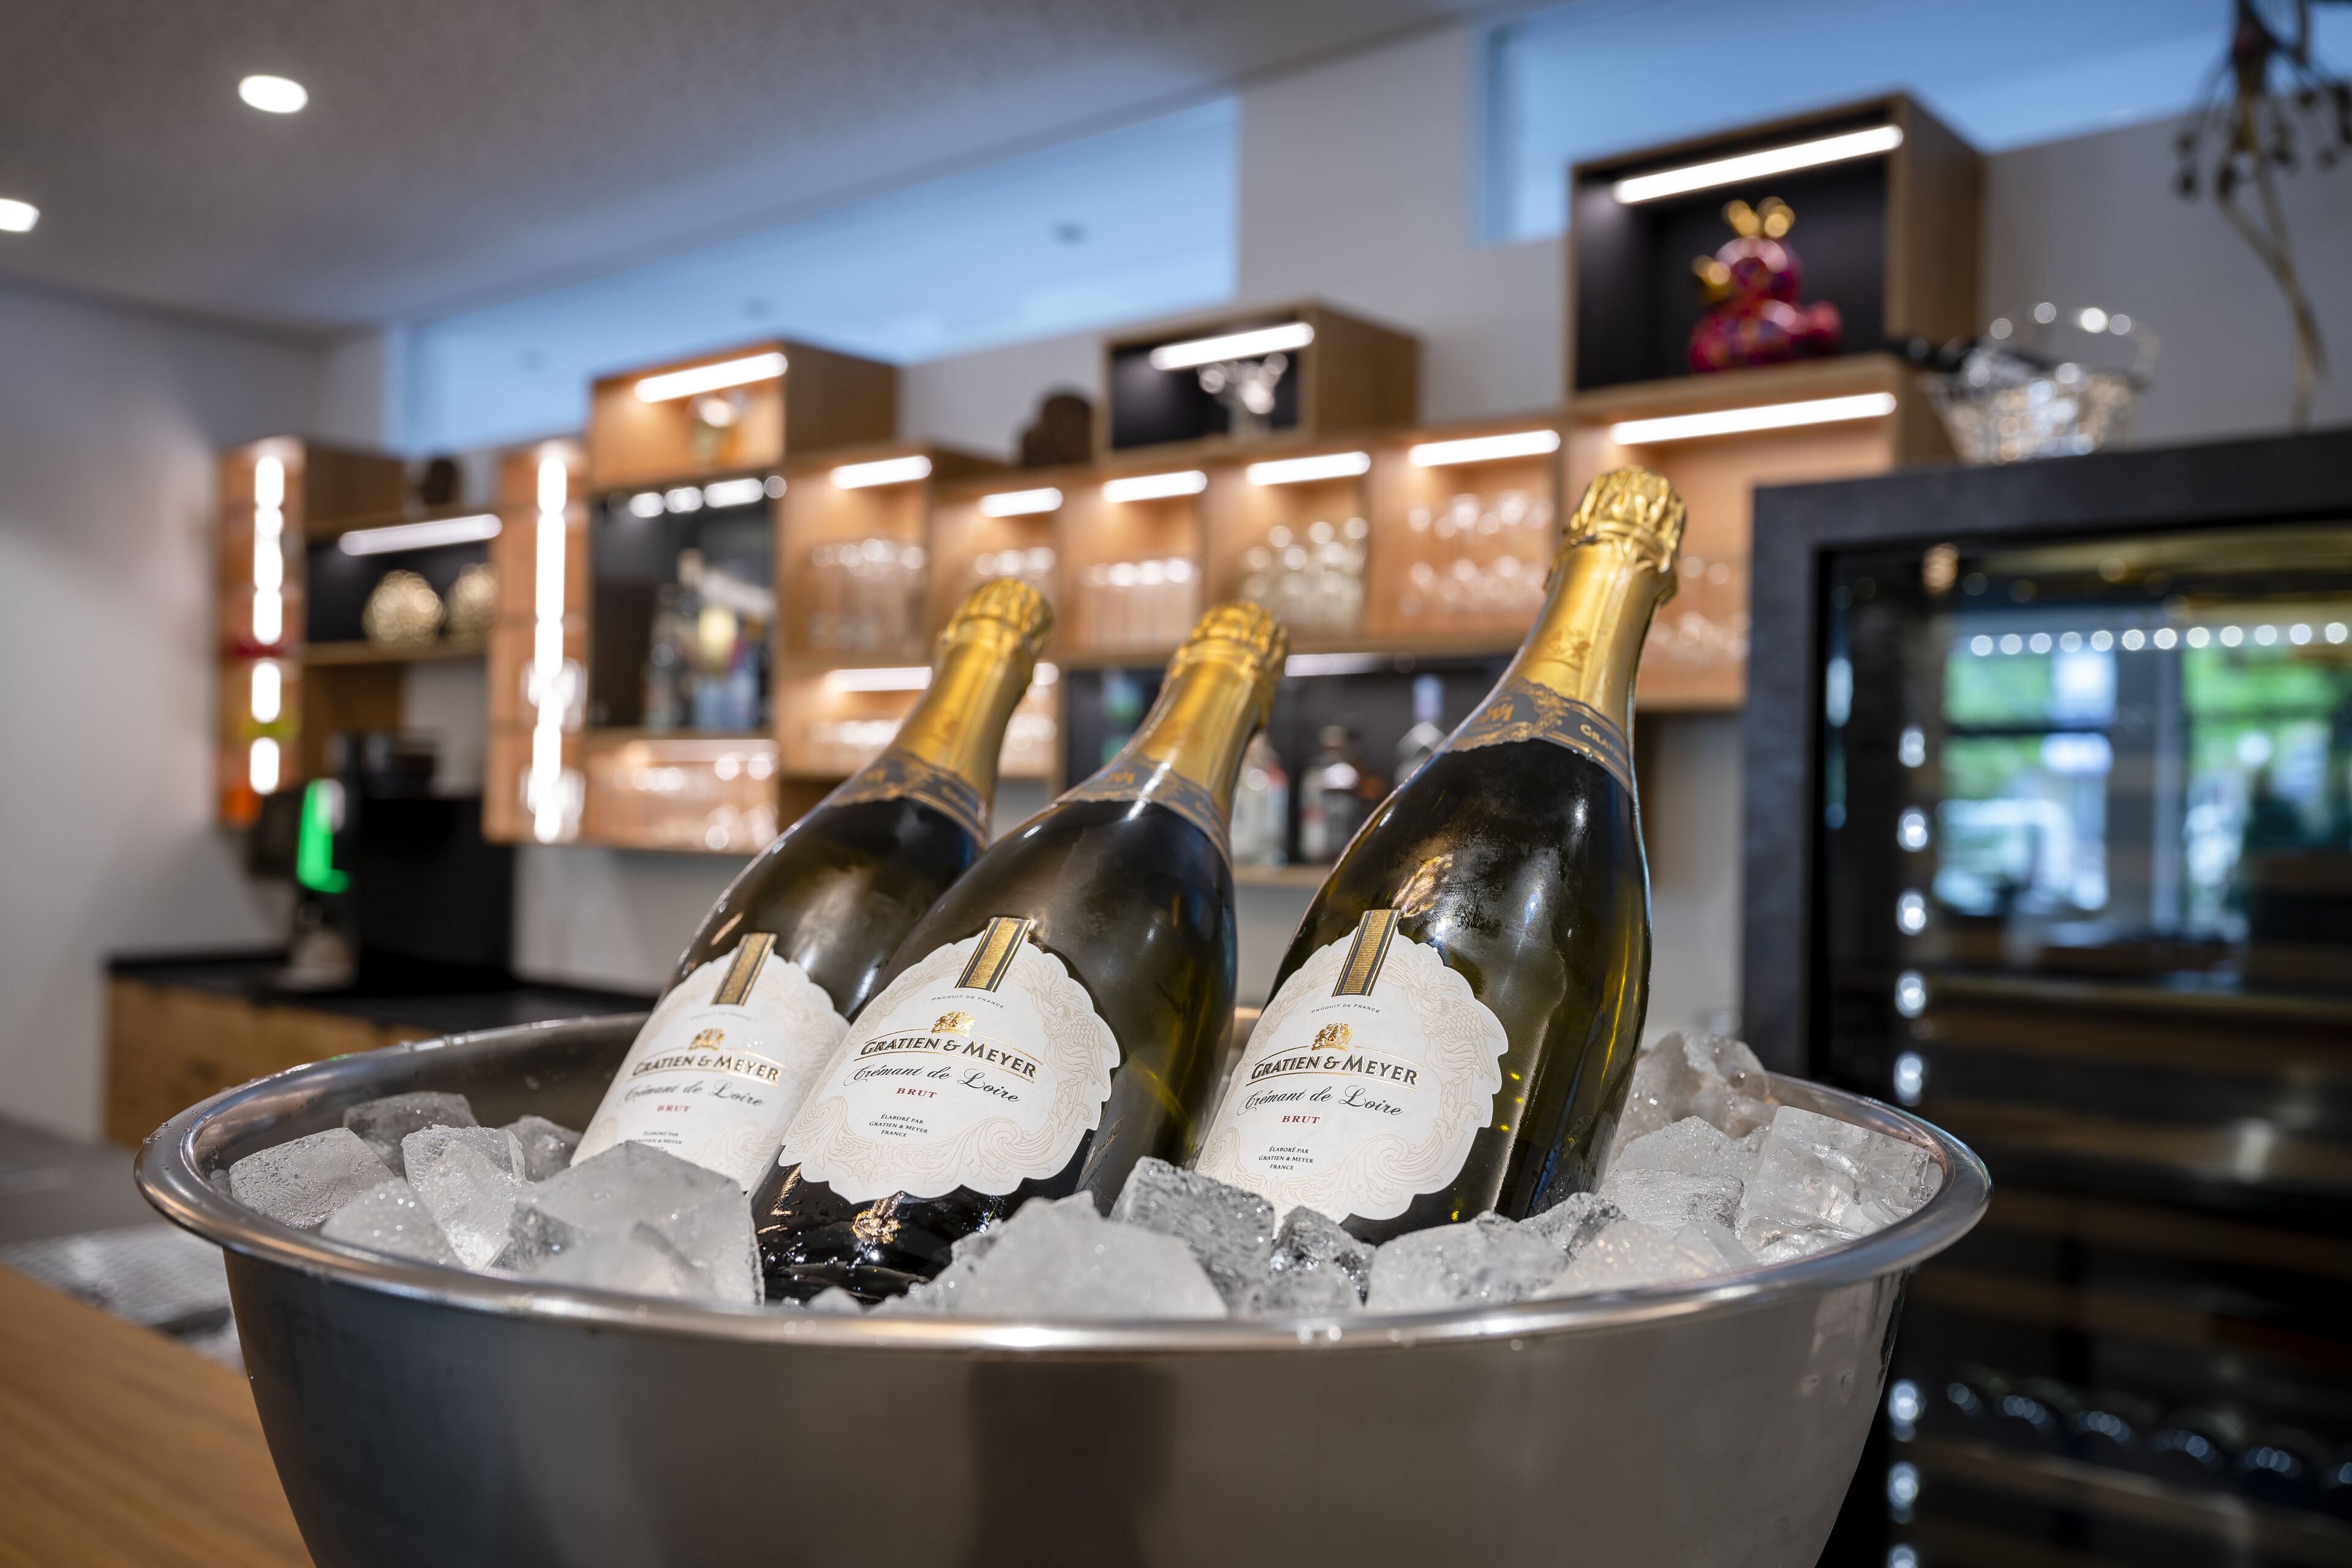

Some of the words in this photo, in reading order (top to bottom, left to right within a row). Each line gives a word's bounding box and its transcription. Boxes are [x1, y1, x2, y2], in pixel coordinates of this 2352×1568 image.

[977, 997, 1005, 1009] FRANCE
[1311, 1004, 1340, 1014] PRODUIT
[1354, 1004, 1380, 1014] FRANCE
[633, 1055, 695, 1076] GRATIEN
[698, 1055, 712, 1067] &
[713, 1054, 782, 1082] MEYER
[861, 1038, 941, 1055] GRATIEN
[943, 1039, 962, 1052] &
[961, 1041, 1038, 1079] MEYER
[1251, 1055, 1322, 1080] GRATIEN
[1323, 1056, 1341, 1069] &
[1341, 1054, 1420, 1086] MEYER
[683, 1080, 704, 1094] de
[708, 1079, 765, 1107] Loire
[843, 1064, 925, 1087] Crémant
[927, 1066, 952, 1080] de
[957, 1068, 1020, 1102] Loire
[895, 1087, 938, 1098] BRUT
[1237, 1088, 1308, 1116] Crémant
[1309, 1086, 1333, 1102] de
[1338, 1085, 1404, 1115] Loire
[905, 1125, 928, 1134] MEYER
[1281, 1115, 1321, 1124] BRUT
